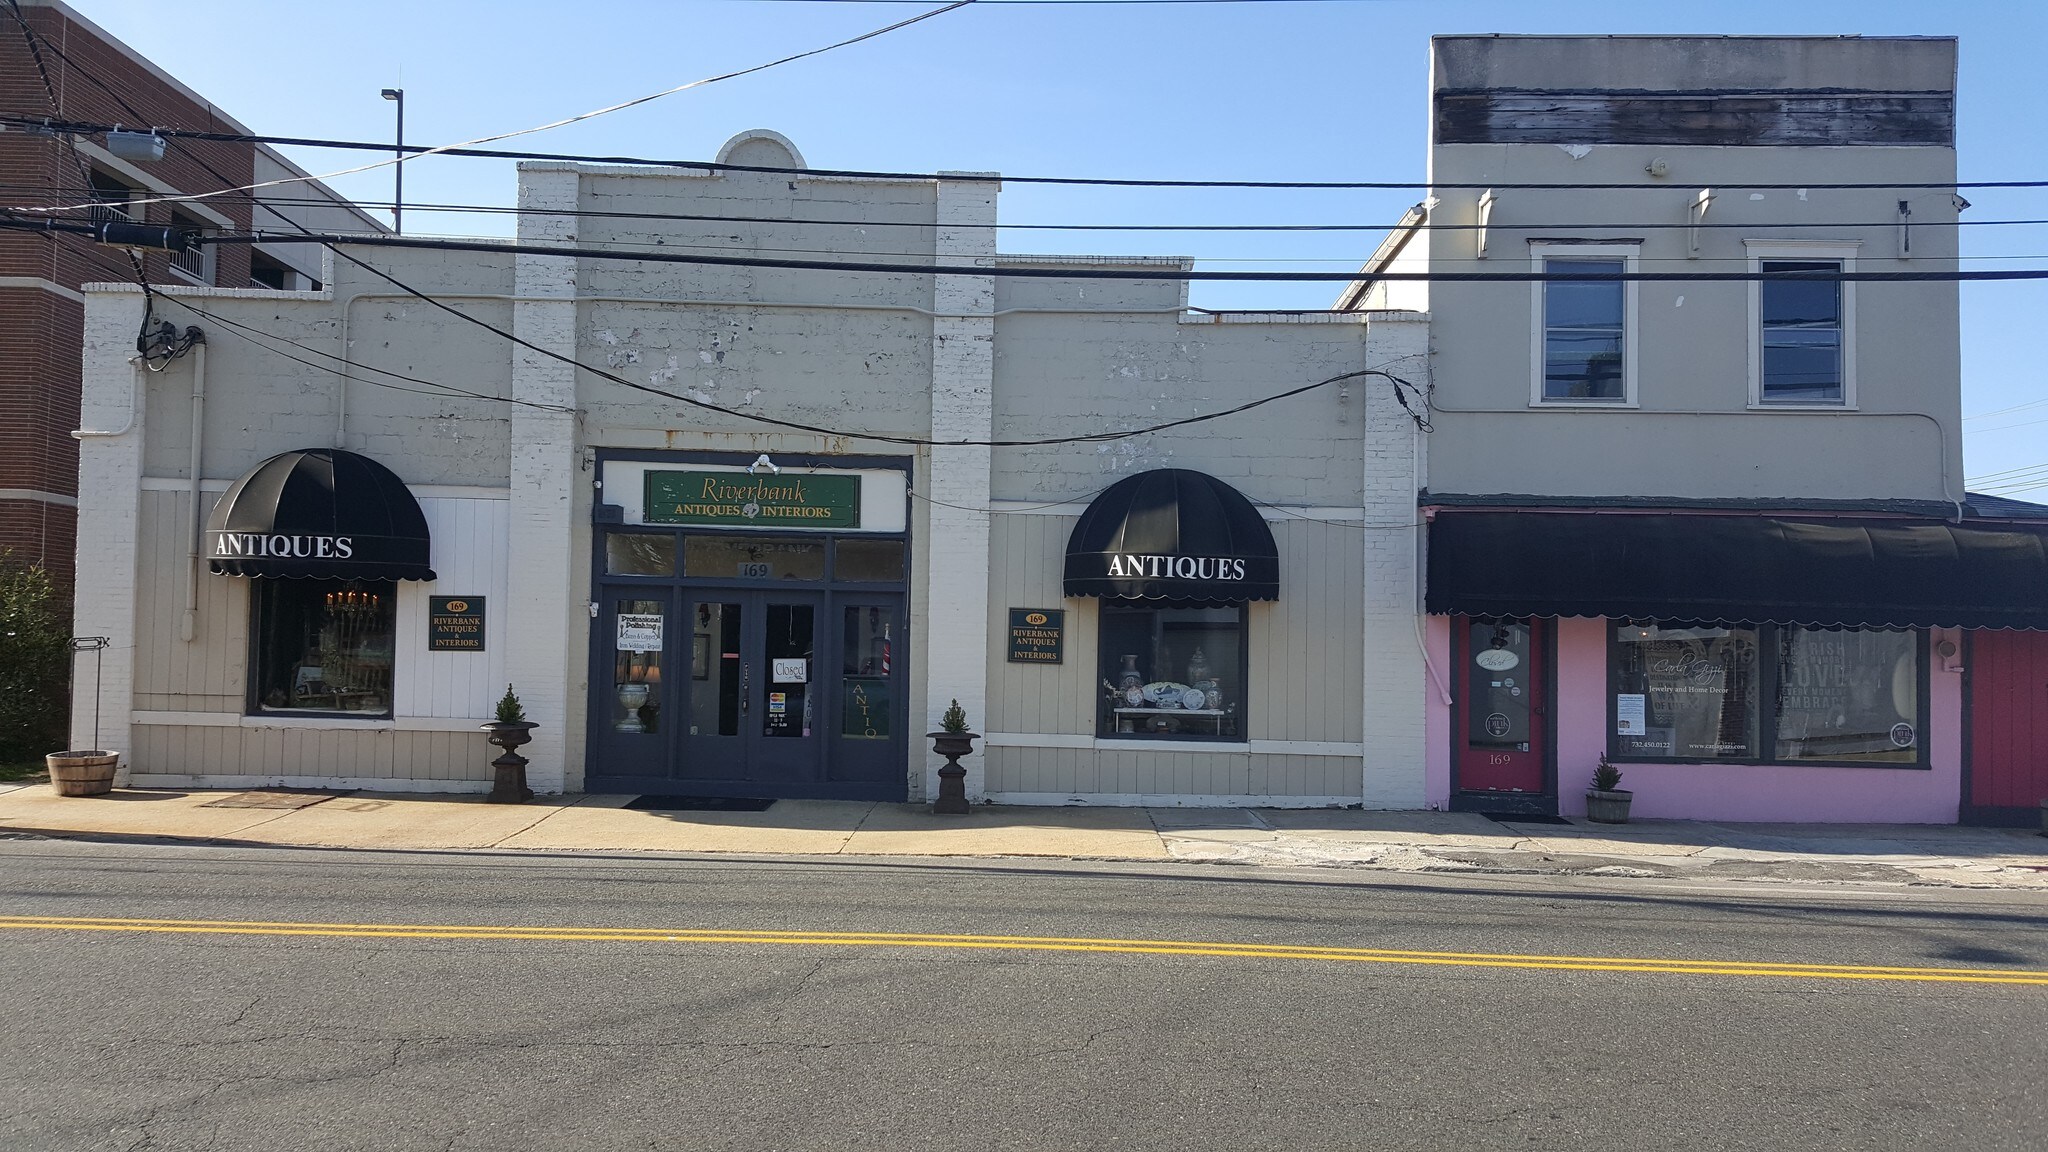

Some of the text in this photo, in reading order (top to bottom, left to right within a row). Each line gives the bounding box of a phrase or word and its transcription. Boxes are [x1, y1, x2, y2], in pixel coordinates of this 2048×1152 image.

[701, 478, 808, 504] Riverbank
[674, 504, 740, 517] ANTIQUES
[762, 506, 831, 518] INTERIORS
[215, 533, 353, 559] ANTIQUES
[743, 564, 768, 577] 169
[1107, 554, 1245, 580] ANTIQUES
[451, 602, 464, 611] 169
[433, 617, 481, 625] RIVERBANK
[621, 615, 661, 623] Professional
[1029, 615, 1043, 623] 169
[437, 625, 478, 633] ANTIQUES
[625, 622, 656, 630] Polishing
[1013, 629, 1059, 638] RIVERBANK
[435, 639, 479, 647] INTERIORS
[1016, 637, 1056, 646] ANTIQUES
[1781, 642, 1845, 655] CHRISH
[1014, 651, 1057, 660] INTERIORS
[775, 662, 804, 676] Closed
[1654, 652, 1725, 685] Carla Gizzi
[1781, 664, 1845, 687] LOVE
[853, 684, 877, 739] ANTIQ
[1490, 754, 1511, 765] 169
